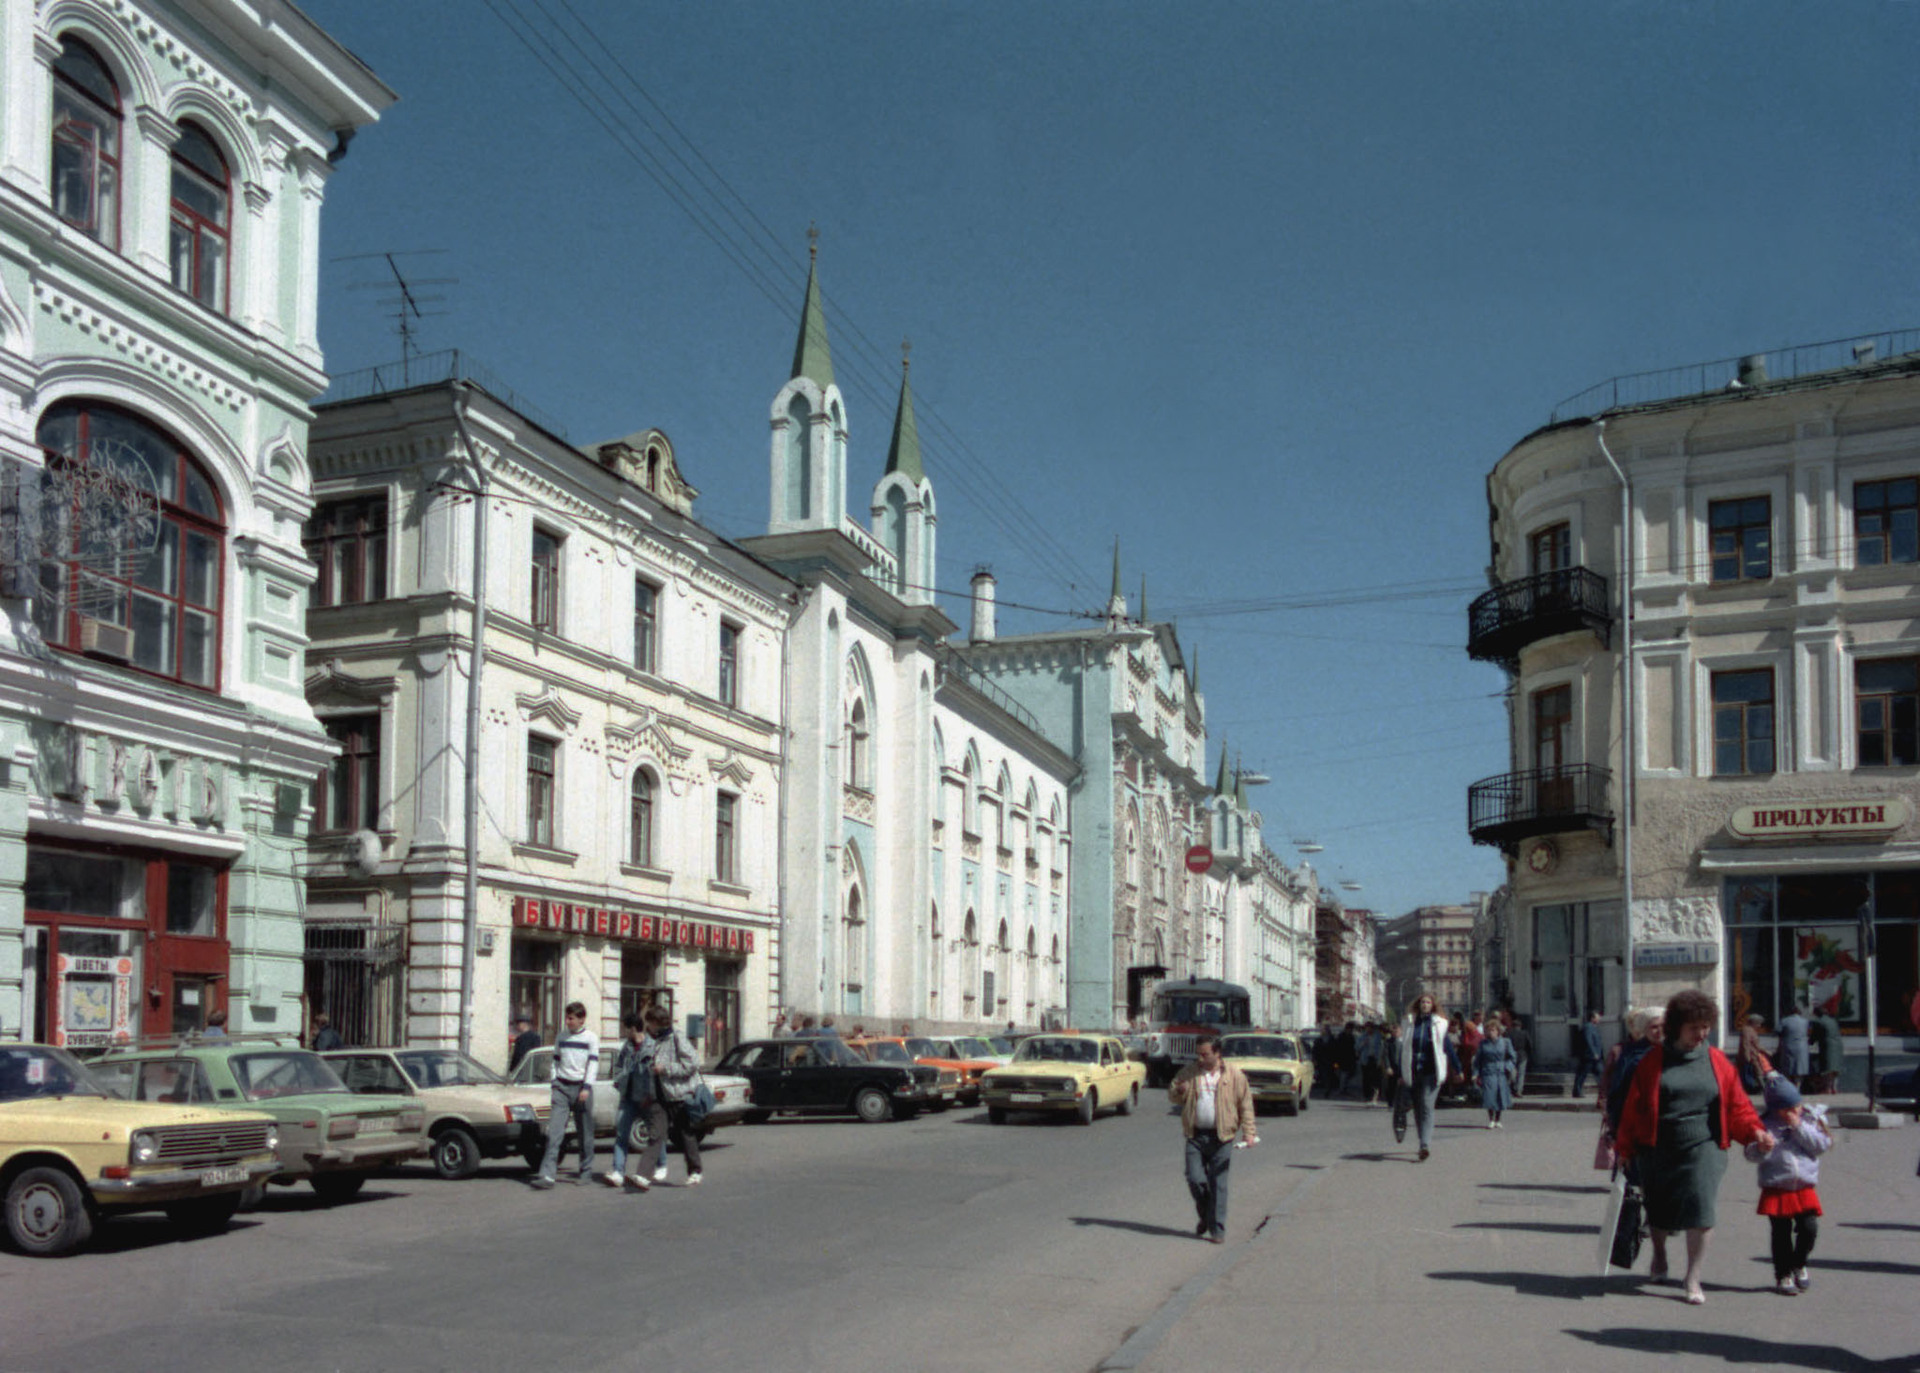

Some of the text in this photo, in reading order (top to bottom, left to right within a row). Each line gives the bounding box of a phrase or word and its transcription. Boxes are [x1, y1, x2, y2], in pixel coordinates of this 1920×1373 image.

[1753, 805, 1886, 828] ПРОДУКТЫ
[525, 900, 755, 953] БУТЕРБРОДНАЯ
[75, 959, 109, 971] ЦВЕТЫ
